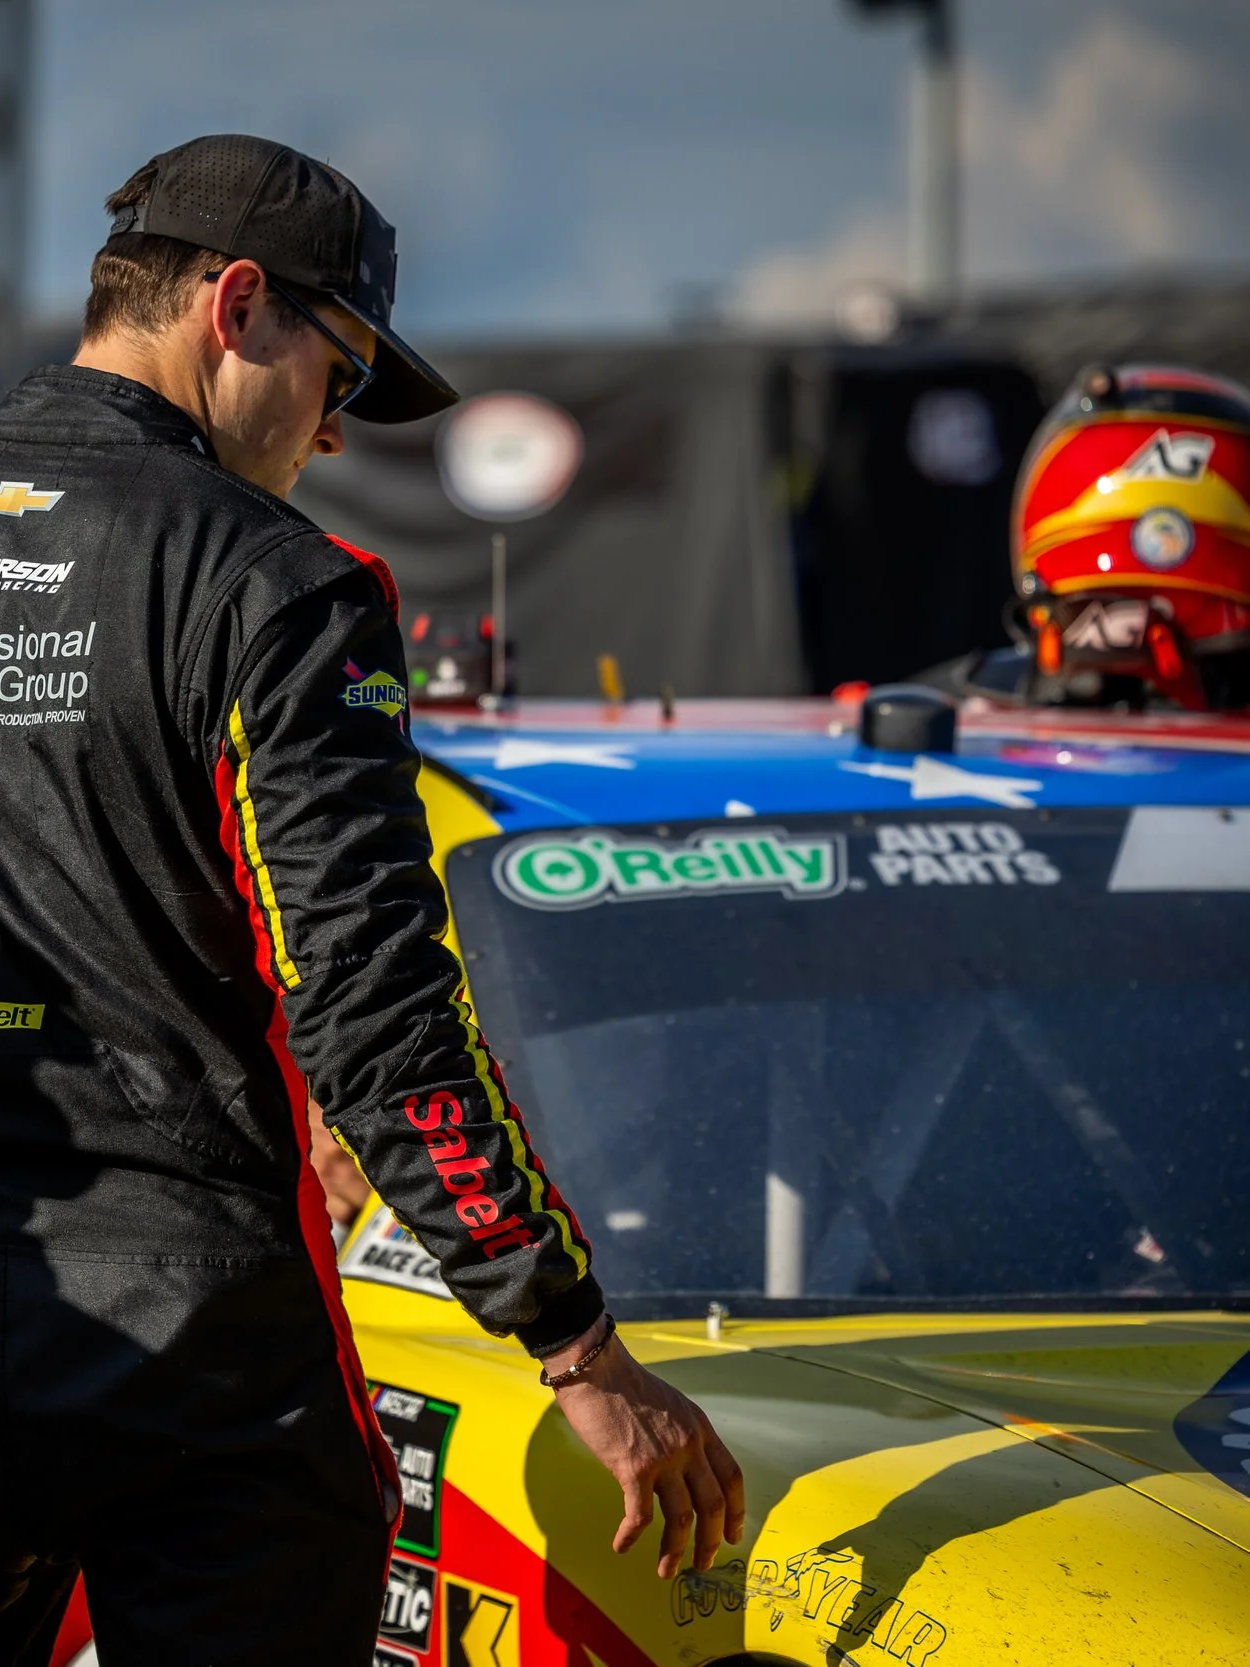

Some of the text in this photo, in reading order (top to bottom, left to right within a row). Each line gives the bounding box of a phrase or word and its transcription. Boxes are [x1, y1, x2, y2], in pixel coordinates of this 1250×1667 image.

[44, 709, 86, 724] PROVEN
[876, 821, 1024, 856] AUTO
[516, 838, 824, 897] O'Reilly
[867, 850, 1062, 886] PARTS
[403, 1090, 535, 1260] Sabelt
